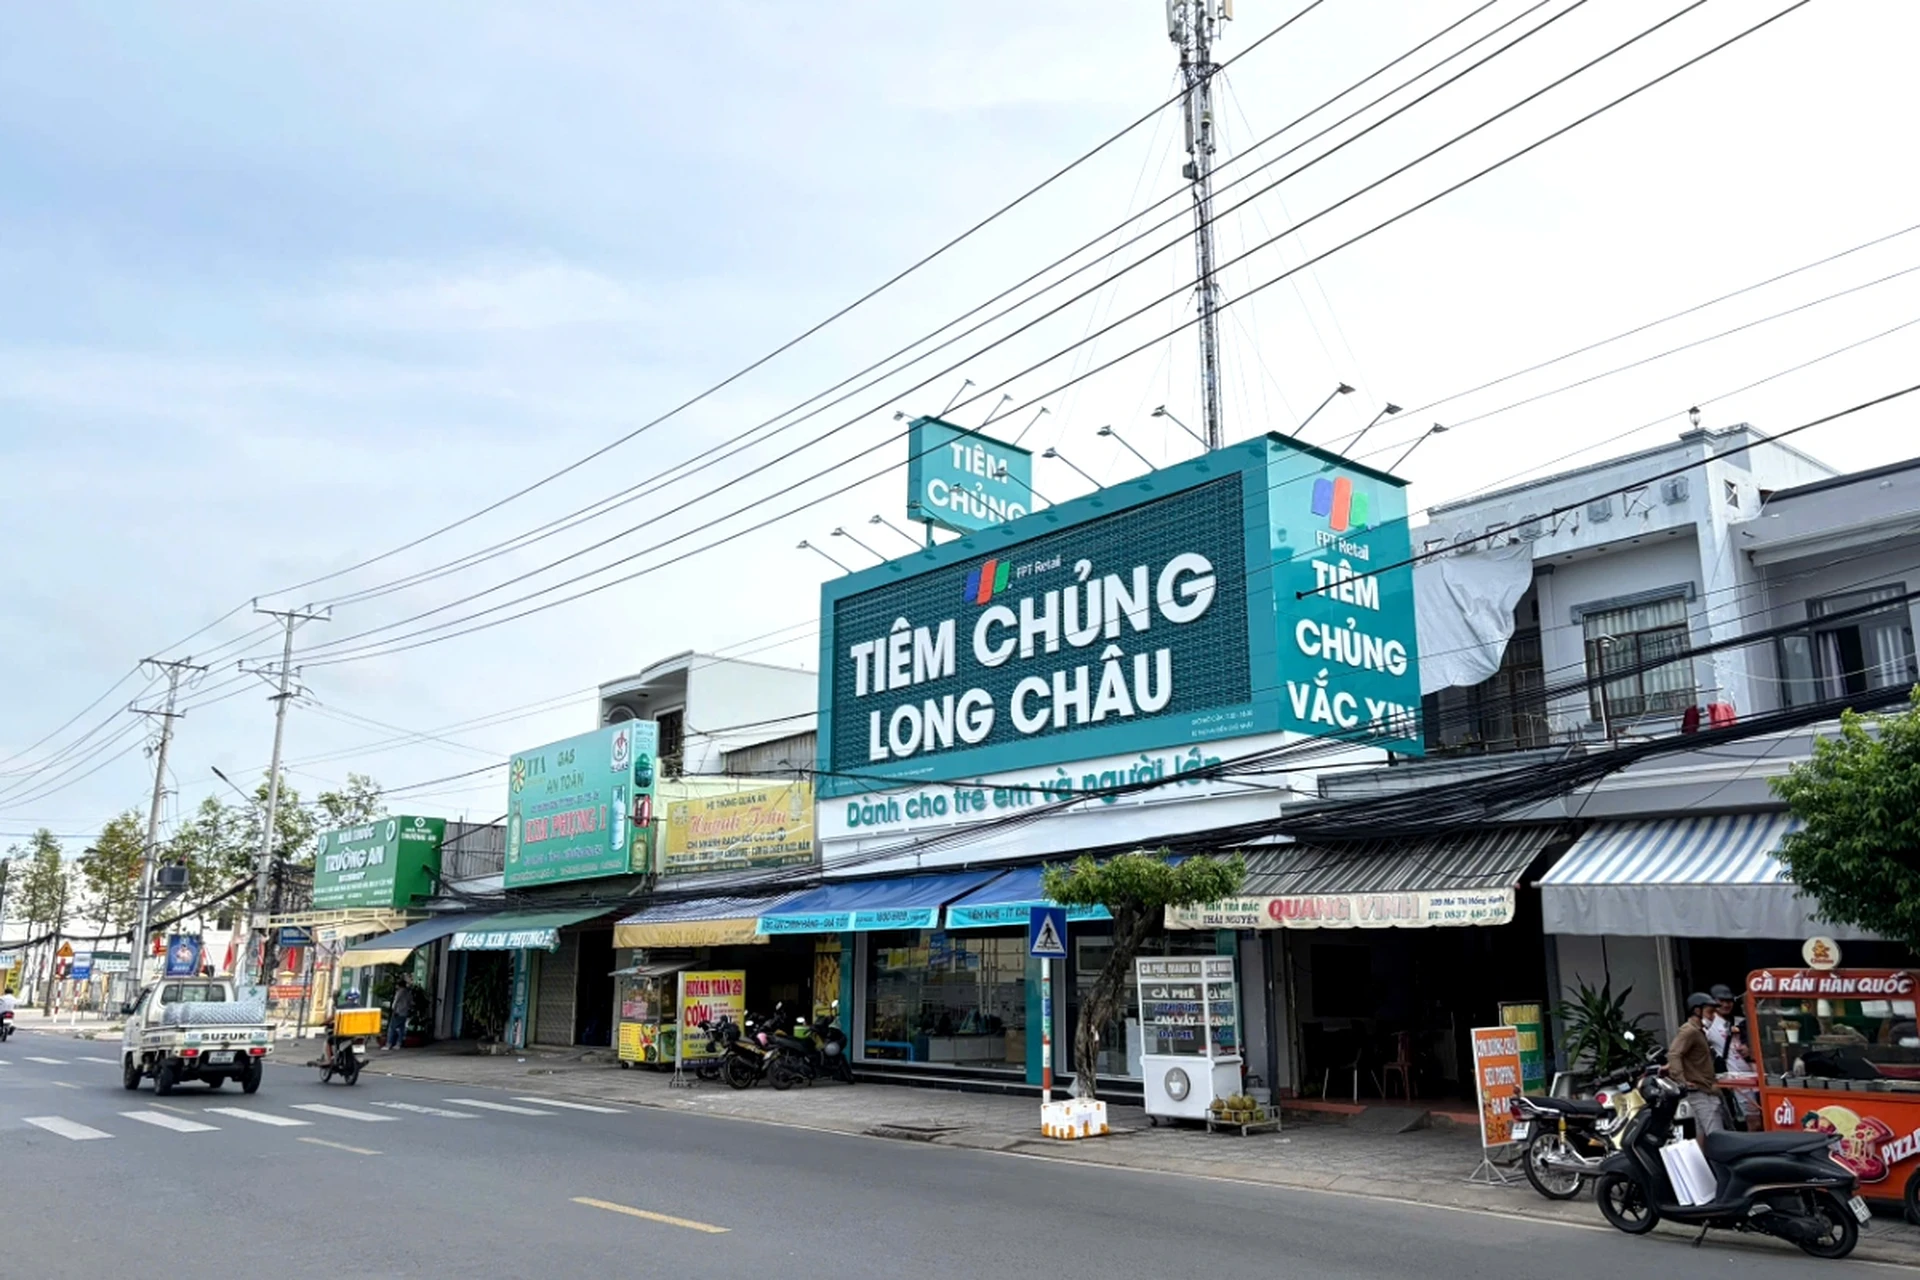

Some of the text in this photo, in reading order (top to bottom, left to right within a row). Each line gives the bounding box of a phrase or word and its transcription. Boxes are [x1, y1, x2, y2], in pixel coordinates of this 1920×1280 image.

[950, 442, 1008, 484] TIÊM
[1316, 530, 1370, 560] FPT Retail
[1016, 553, 1062, 579] FPT Retail
[1312, 558, 1380, 611] TIÊM
[850, 552, 1218, 698] TIÊM CHỦNG
[1296, 616, 1408, 676] CHỦNG
[868, 643, 1174, 762] LONG CHÂU
[1287, 667, 1419, 742] VẮC XIN
[846, 746, 1224, 829] Dành cho trẻ em và người lớn
[324, 844, 386, 873] TRƯỜNG AN
[1267, 893, 1420, 923] QUANG VINH
[1151, 986, 1196, 999] CÀ PHÊ
[1750, 970, 1912, 994] GÀ RÁN HÀN QUỐC
[685, 1000, 709, 1028] CƠM
[201, 1031, 252, 1042] SUZUKI
[1774, 1097, 1795, 1126] GÀ
